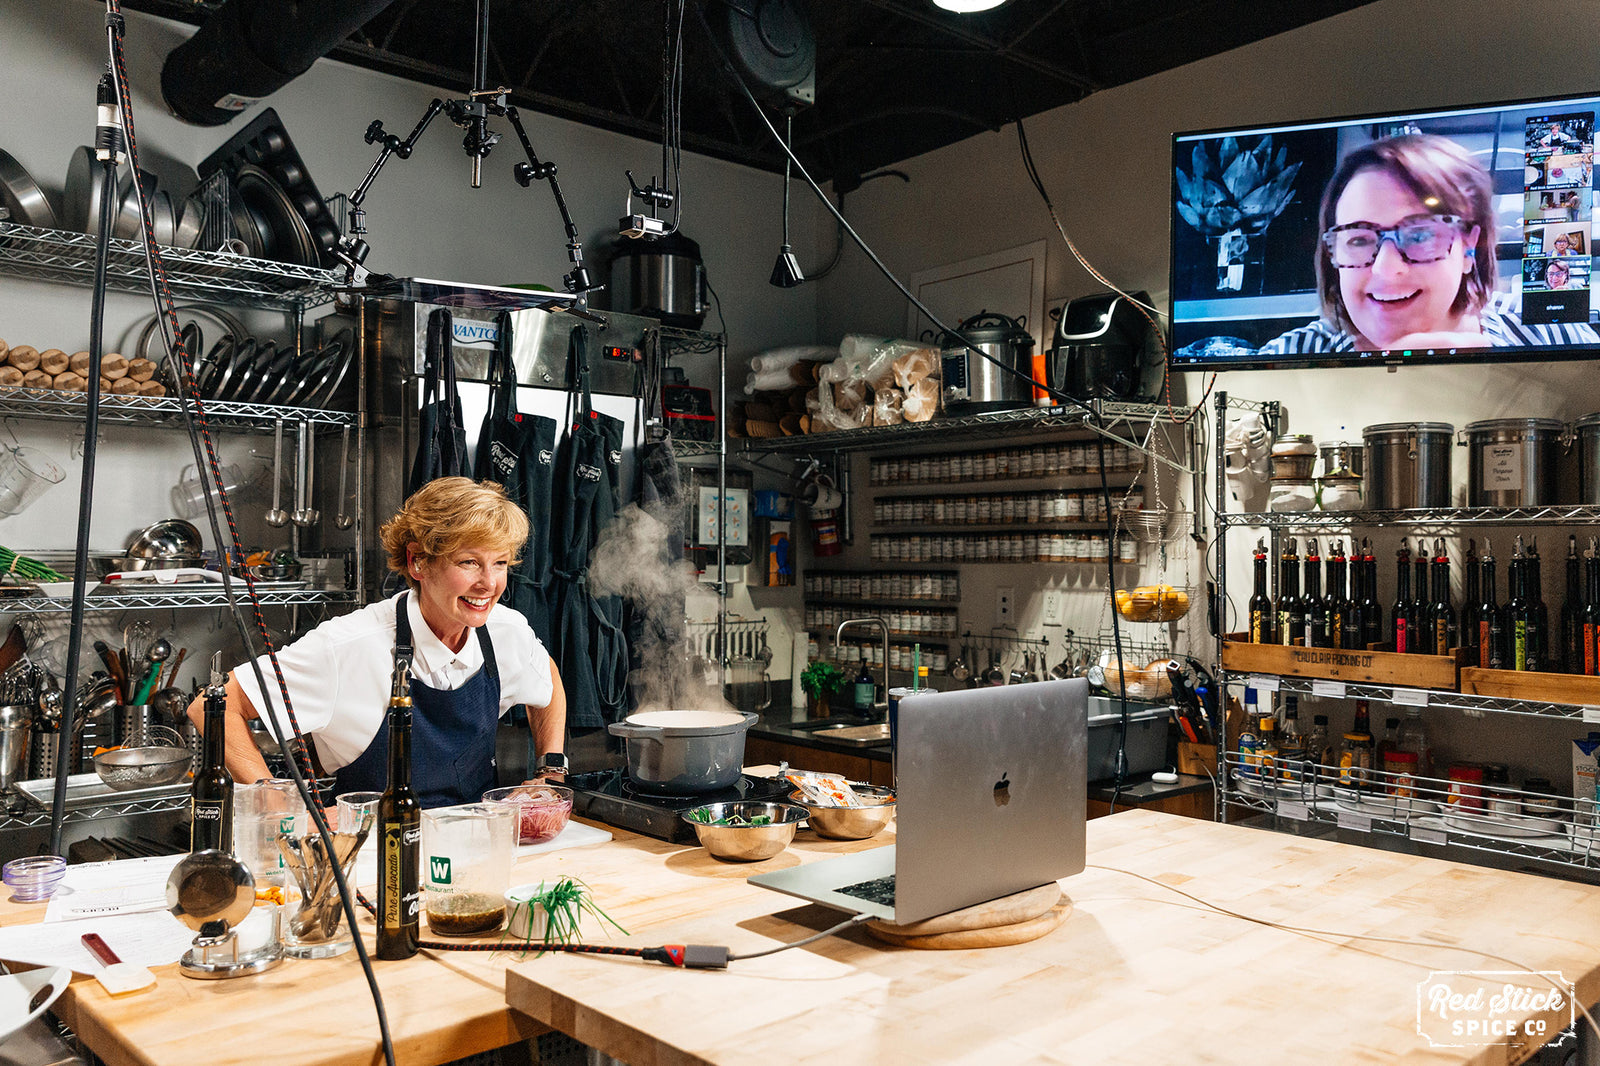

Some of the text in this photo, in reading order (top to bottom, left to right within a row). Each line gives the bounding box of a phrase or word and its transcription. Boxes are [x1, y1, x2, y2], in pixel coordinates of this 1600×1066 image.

[386, 853, 398, 922] Pure Avocado
[432, 861, 449, 880] W
